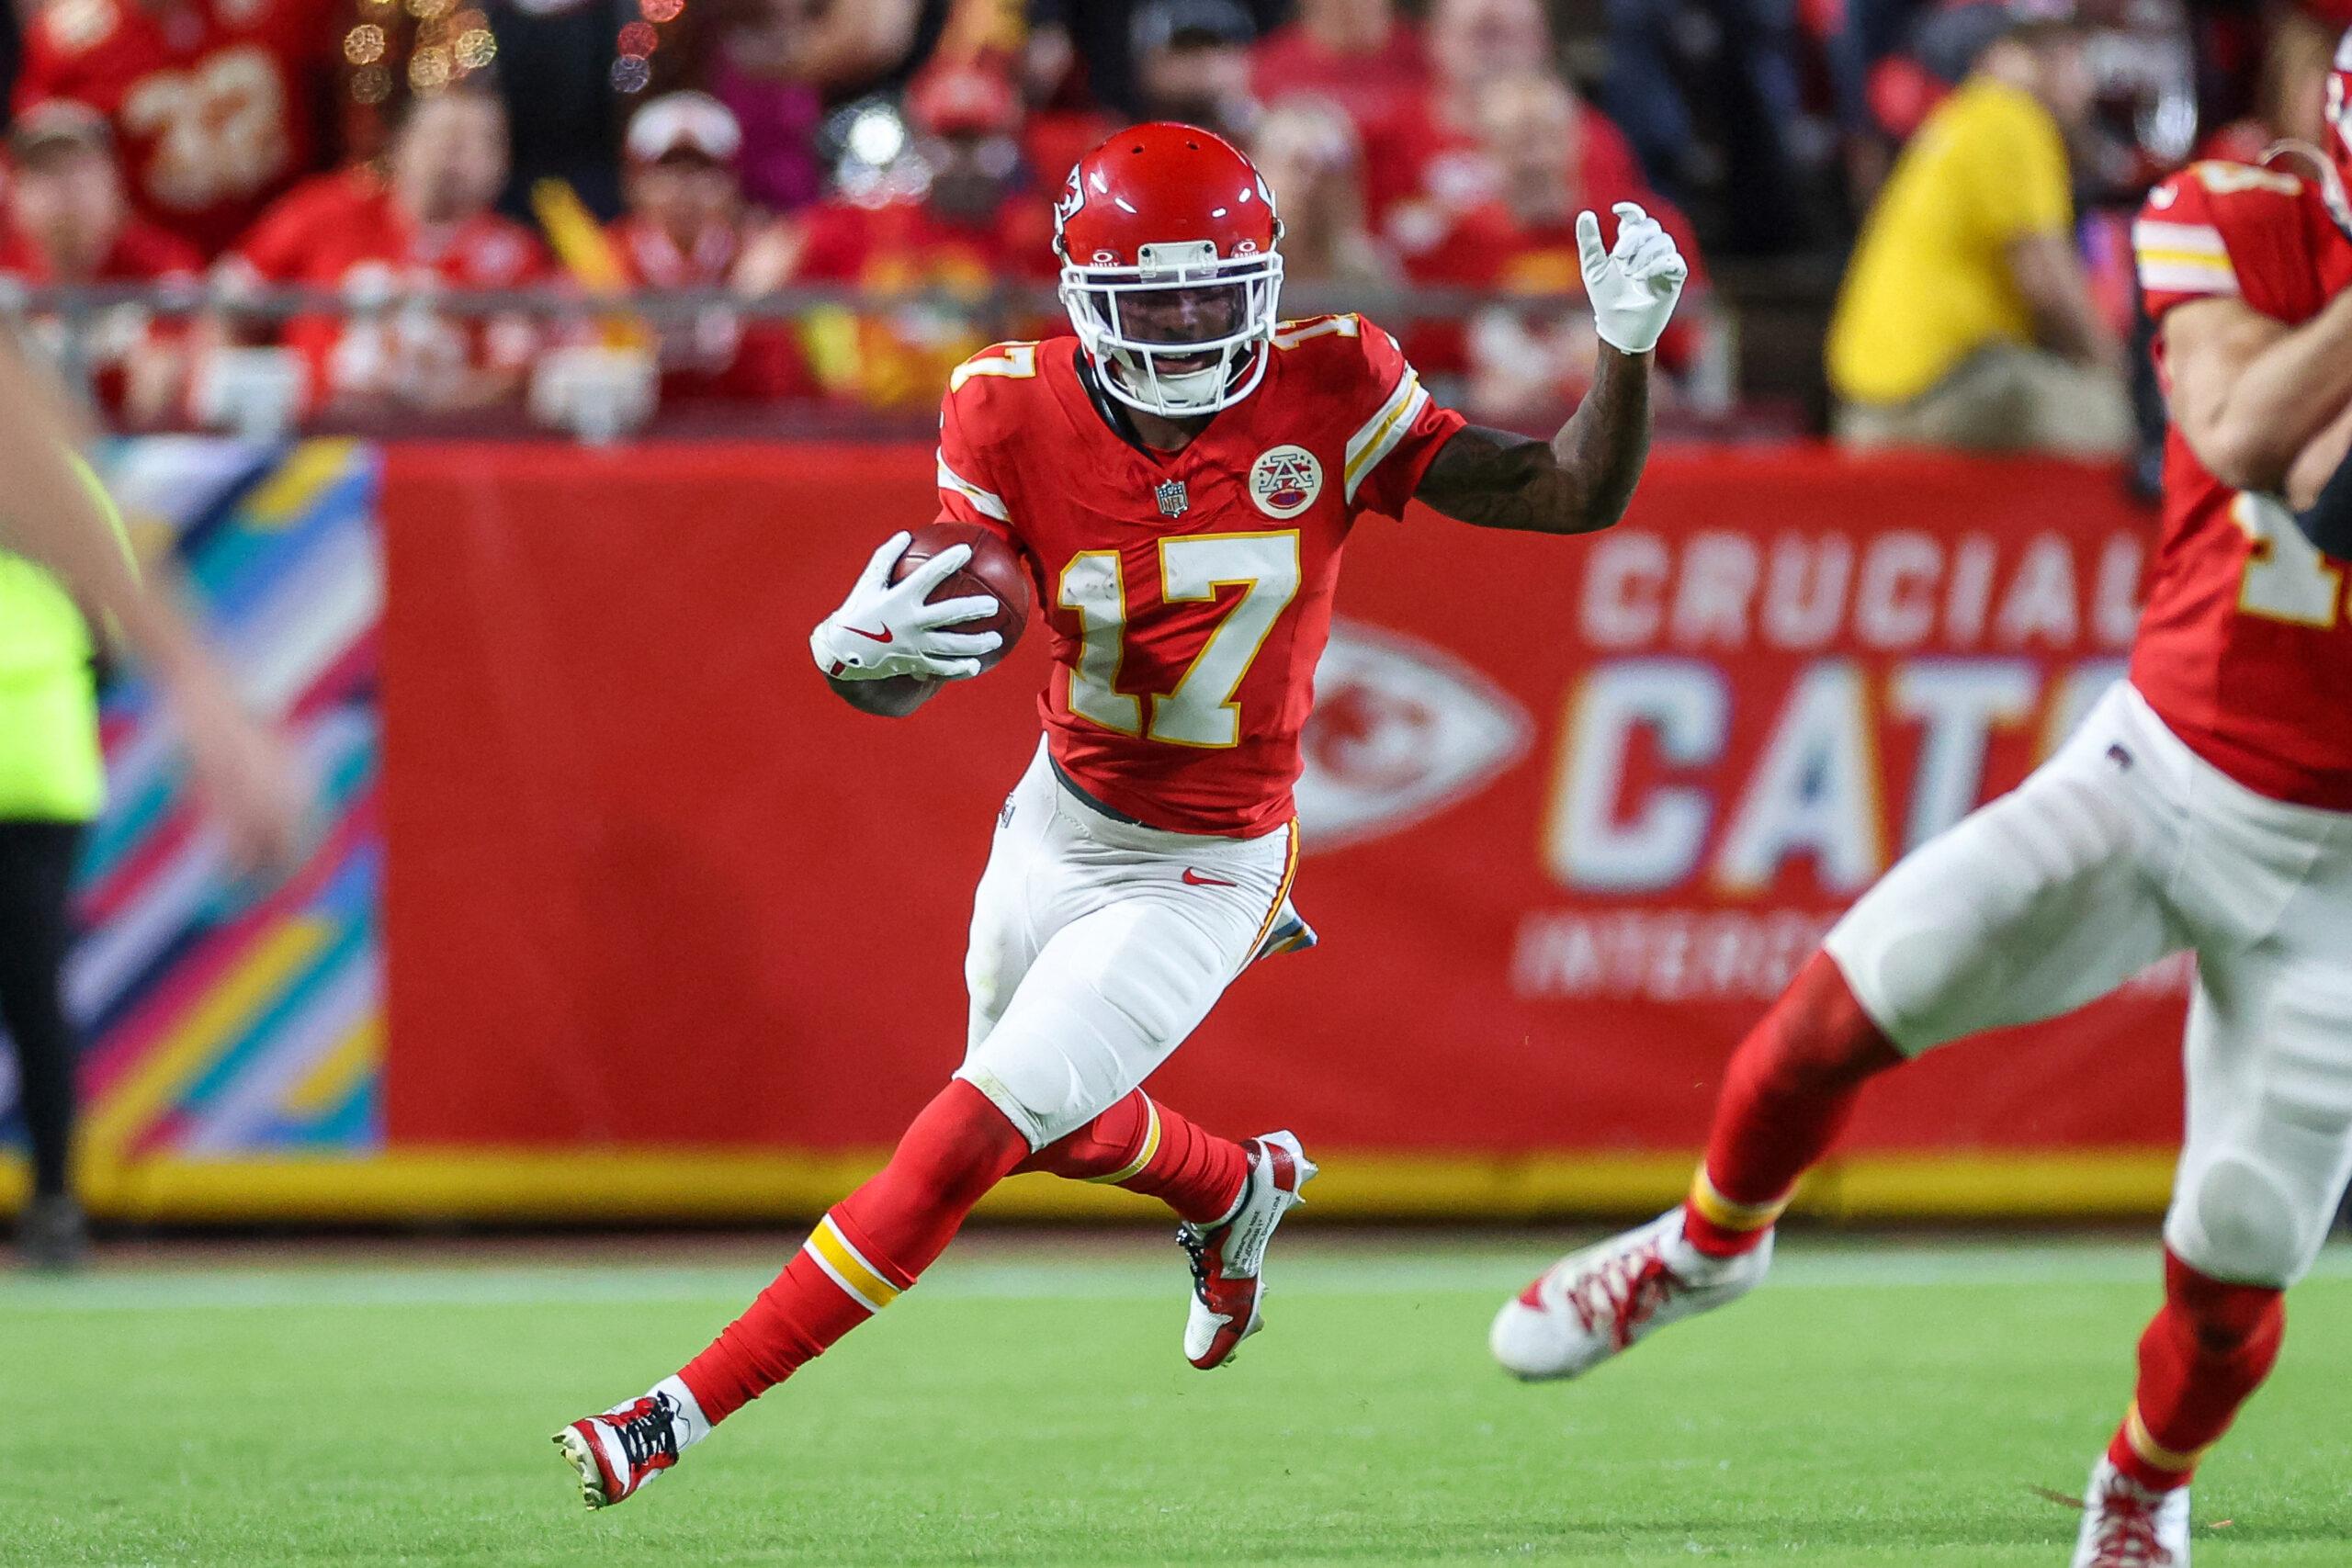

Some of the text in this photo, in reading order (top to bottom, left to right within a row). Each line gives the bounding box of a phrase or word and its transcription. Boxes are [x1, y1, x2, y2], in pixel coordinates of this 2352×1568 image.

[1057, 529, 1301, 749] 17
[1579, 531, 2143, 647] CRUCIAL
[1511, 908, 1830, 1000] INTERC
